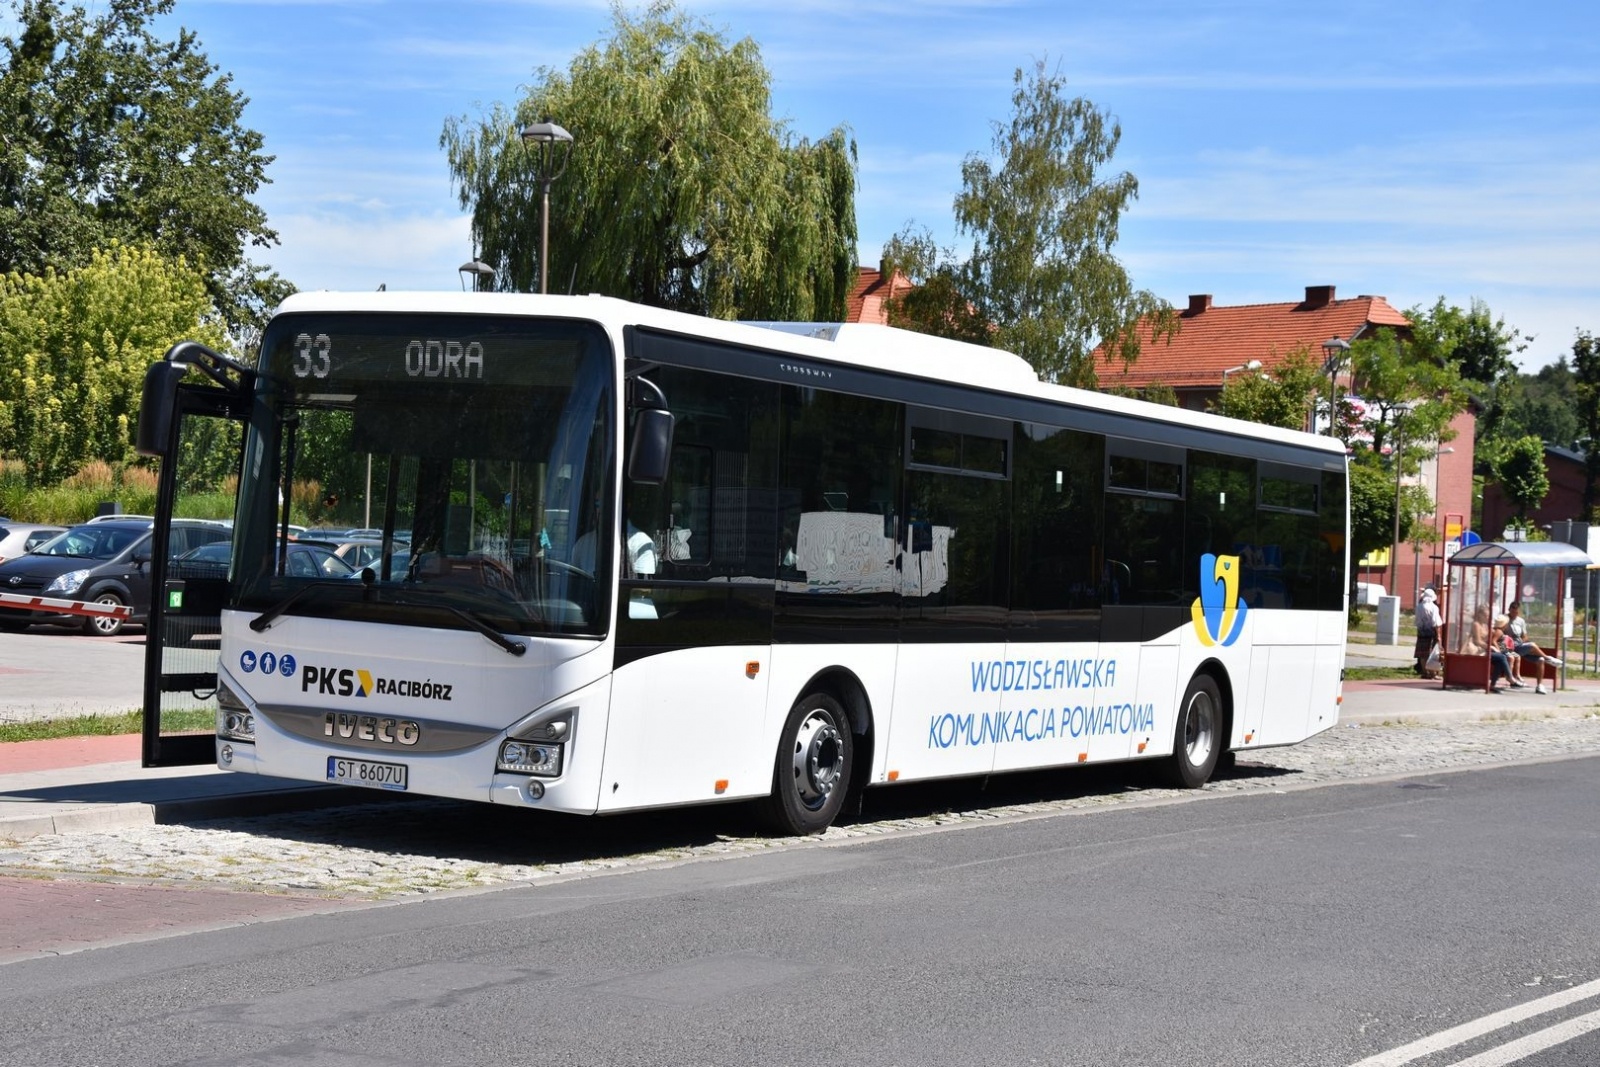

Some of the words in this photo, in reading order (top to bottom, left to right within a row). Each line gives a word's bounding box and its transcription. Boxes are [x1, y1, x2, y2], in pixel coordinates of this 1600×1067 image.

[293, 333, 332, 378] 33
[405, 340, 484, 378] ODRA
[780, 364, 832, 379] CROSSWAY
[302, 665, 354, 696] PKS
[376, 678, 453, 700] RACIBÓRZ
[971, 659, 1116, 692] WODZISŁAWSKA
[324, 712, 420, 746] IVECO
[928, 708, 1055, 749] KOMUNIKACJA
[1060, 703, 1154, 738] POWIATOWA
[337, 761, 355, 778] ST
[360, 764, 402, 783] 8607U
